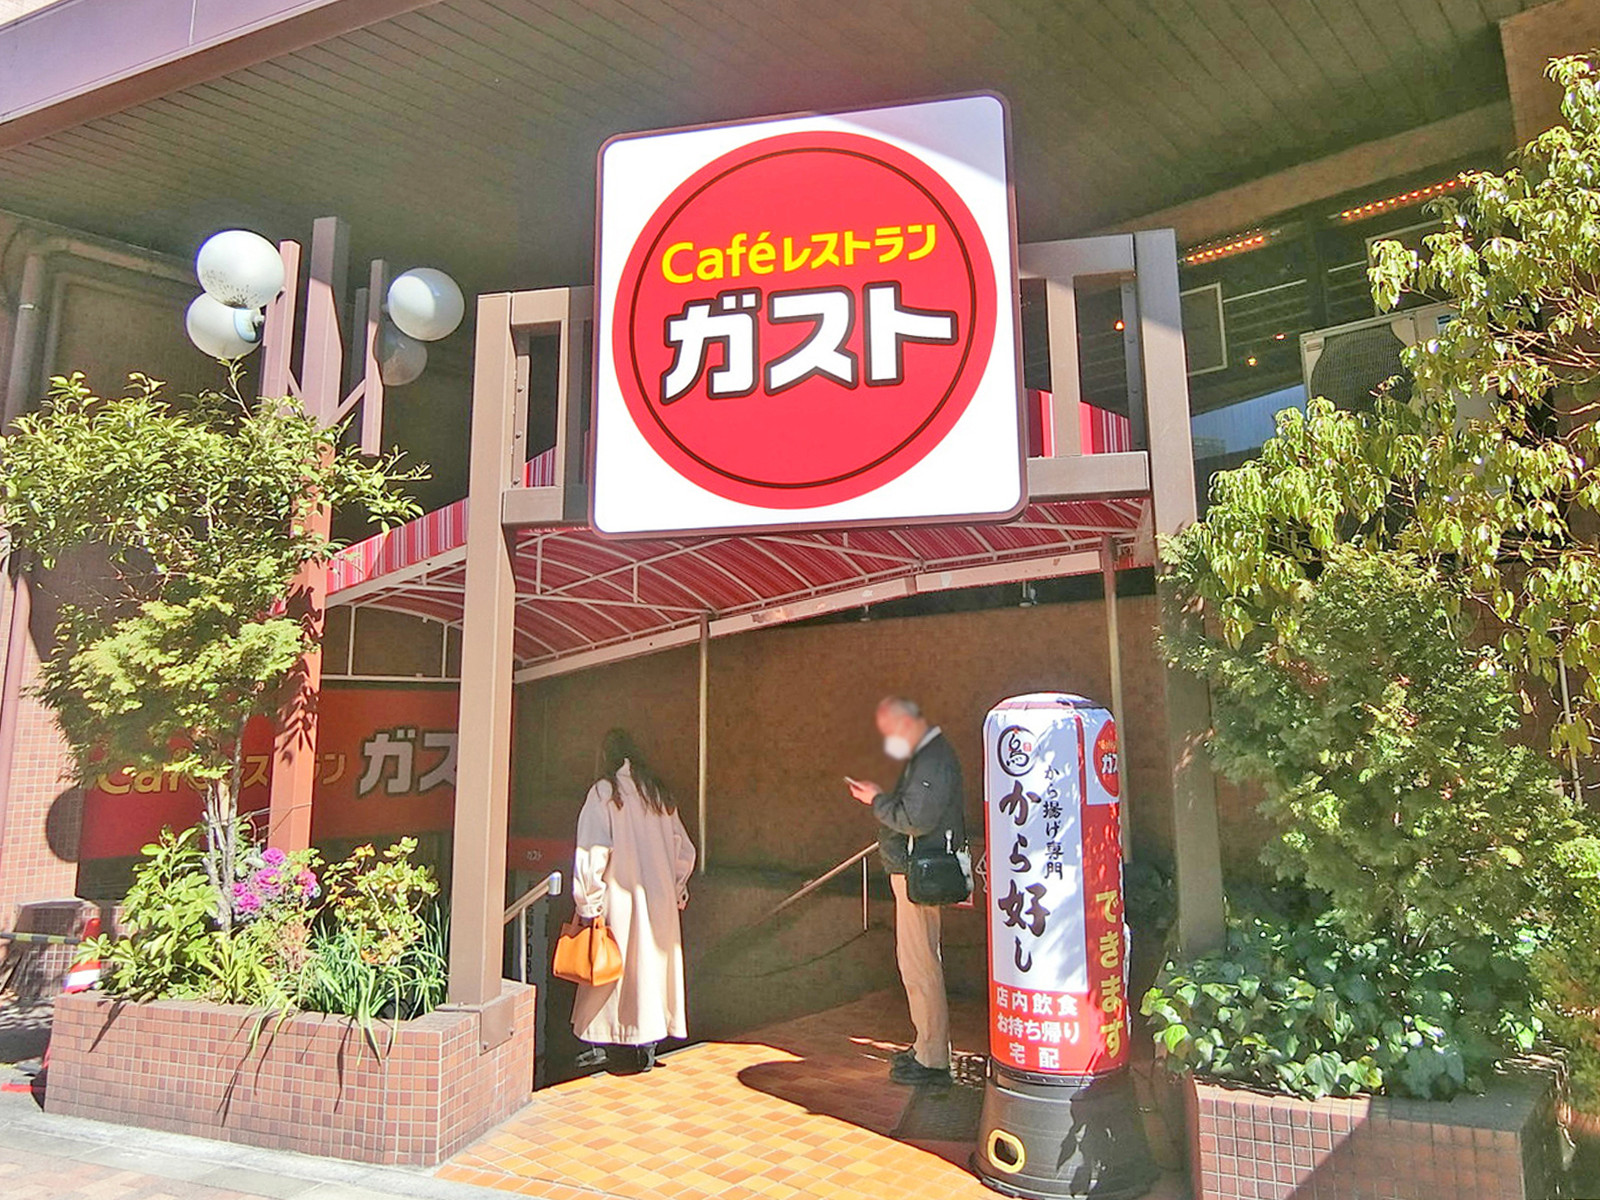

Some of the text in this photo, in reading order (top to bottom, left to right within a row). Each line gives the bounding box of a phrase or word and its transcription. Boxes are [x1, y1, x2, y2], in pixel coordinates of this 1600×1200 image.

[660, 281, 958, 404] ガスト
[999, 780, 1050, 972] から好し
[1043, 765, 1063, 880] から揚げ専門
[996, 987, 1078, 1016] 店内飲食
[997, 1012, 1080, 1044] お持ち帰り
[1096, 889, 1123, 1058] できます
